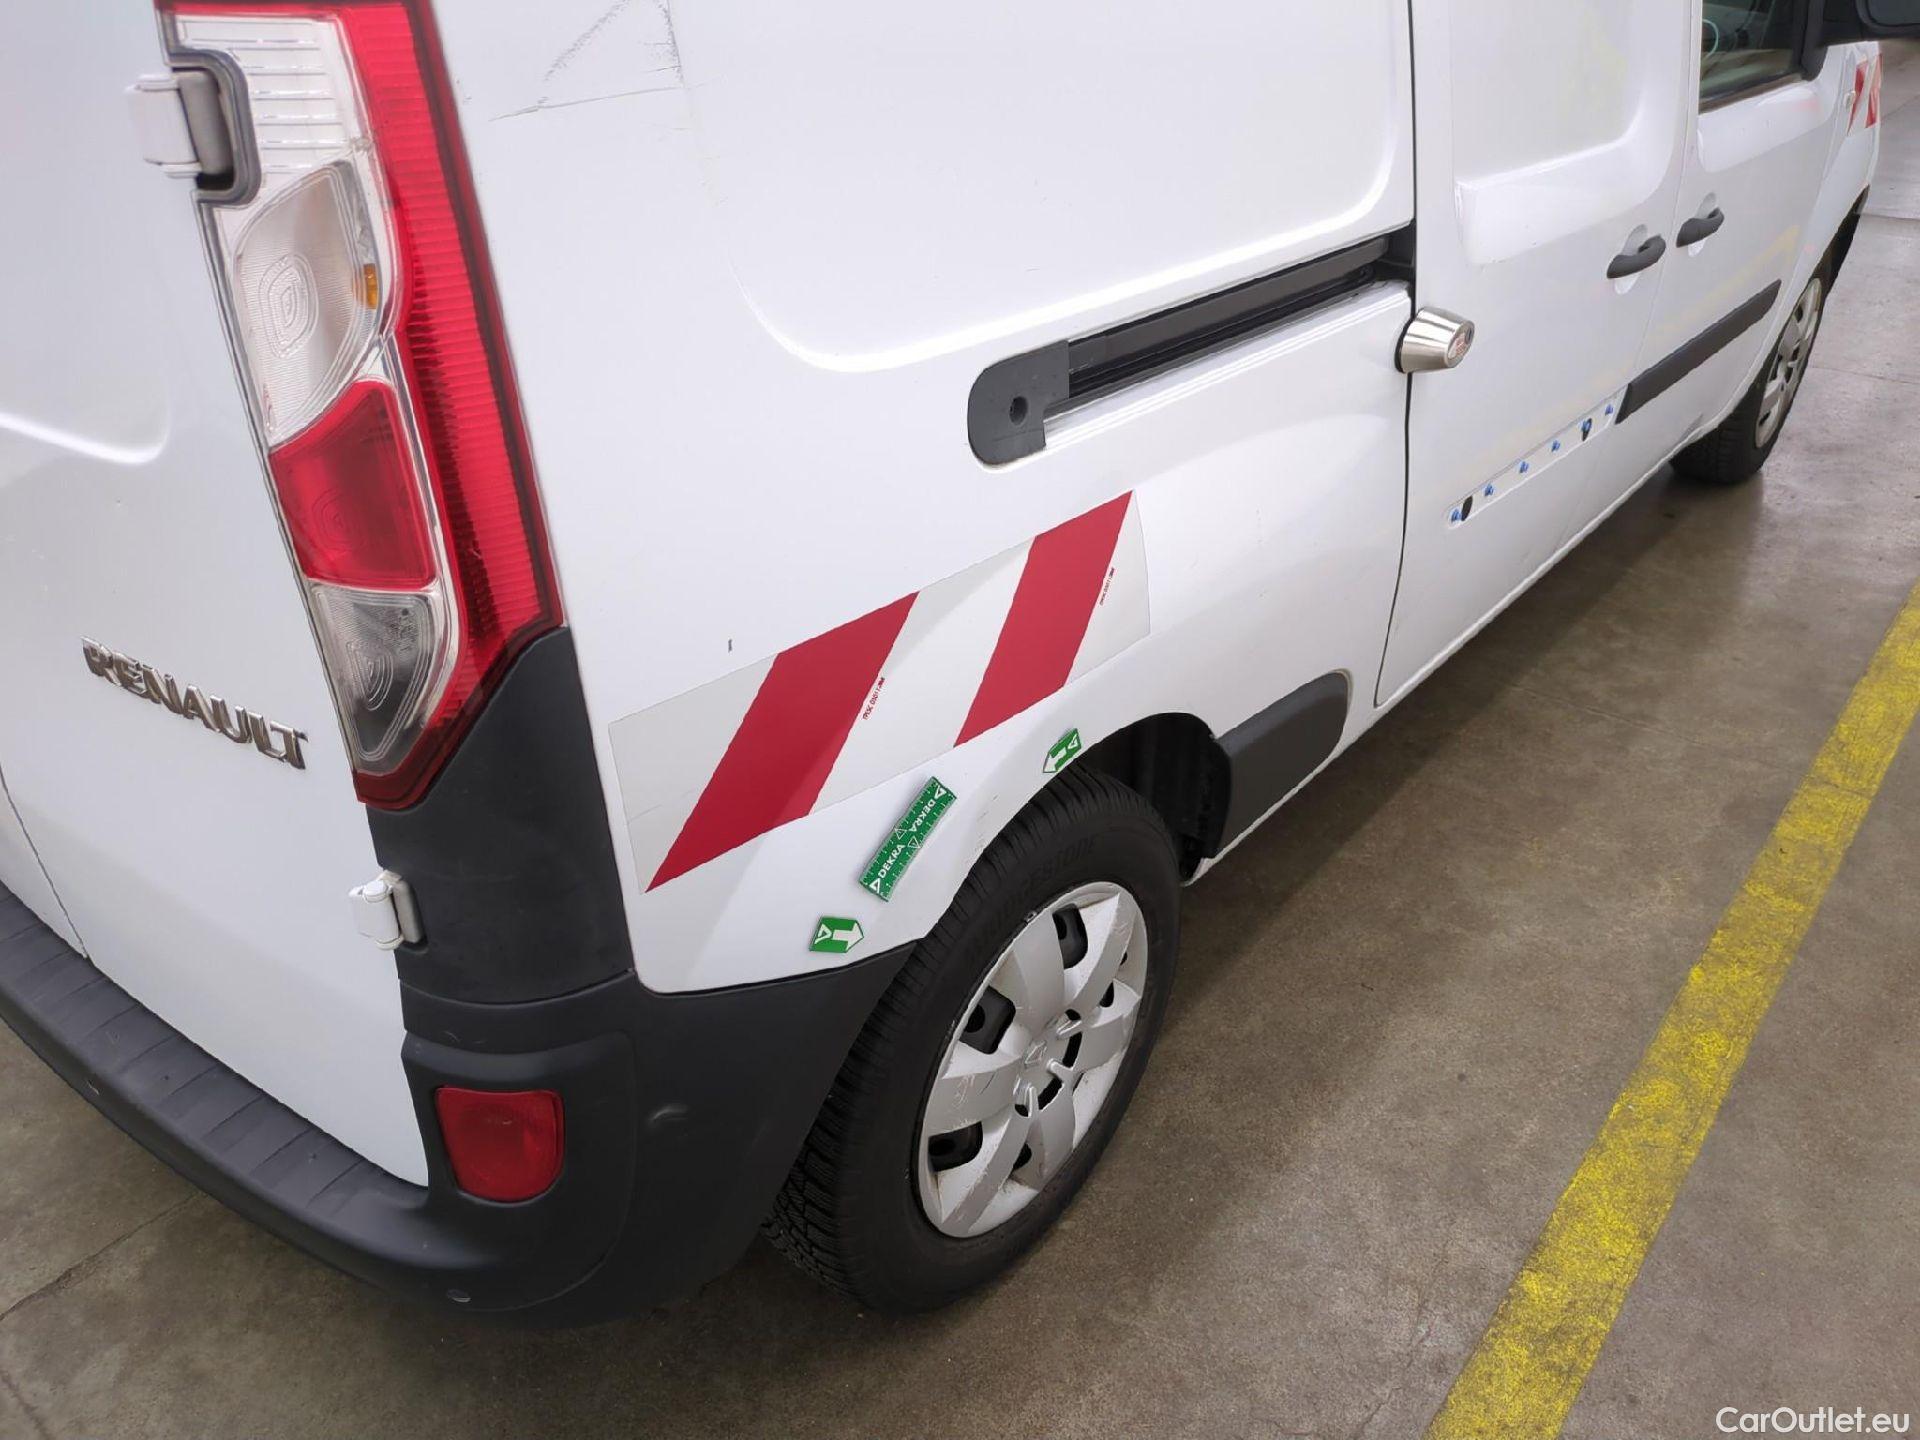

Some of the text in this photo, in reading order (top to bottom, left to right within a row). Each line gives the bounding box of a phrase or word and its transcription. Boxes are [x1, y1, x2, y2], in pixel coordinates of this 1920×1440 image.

[80, 636, 308, 769] RENAULT
[908, 799, 936, 832] DEKRA
[878, 844, 906, 879] DEKRA
